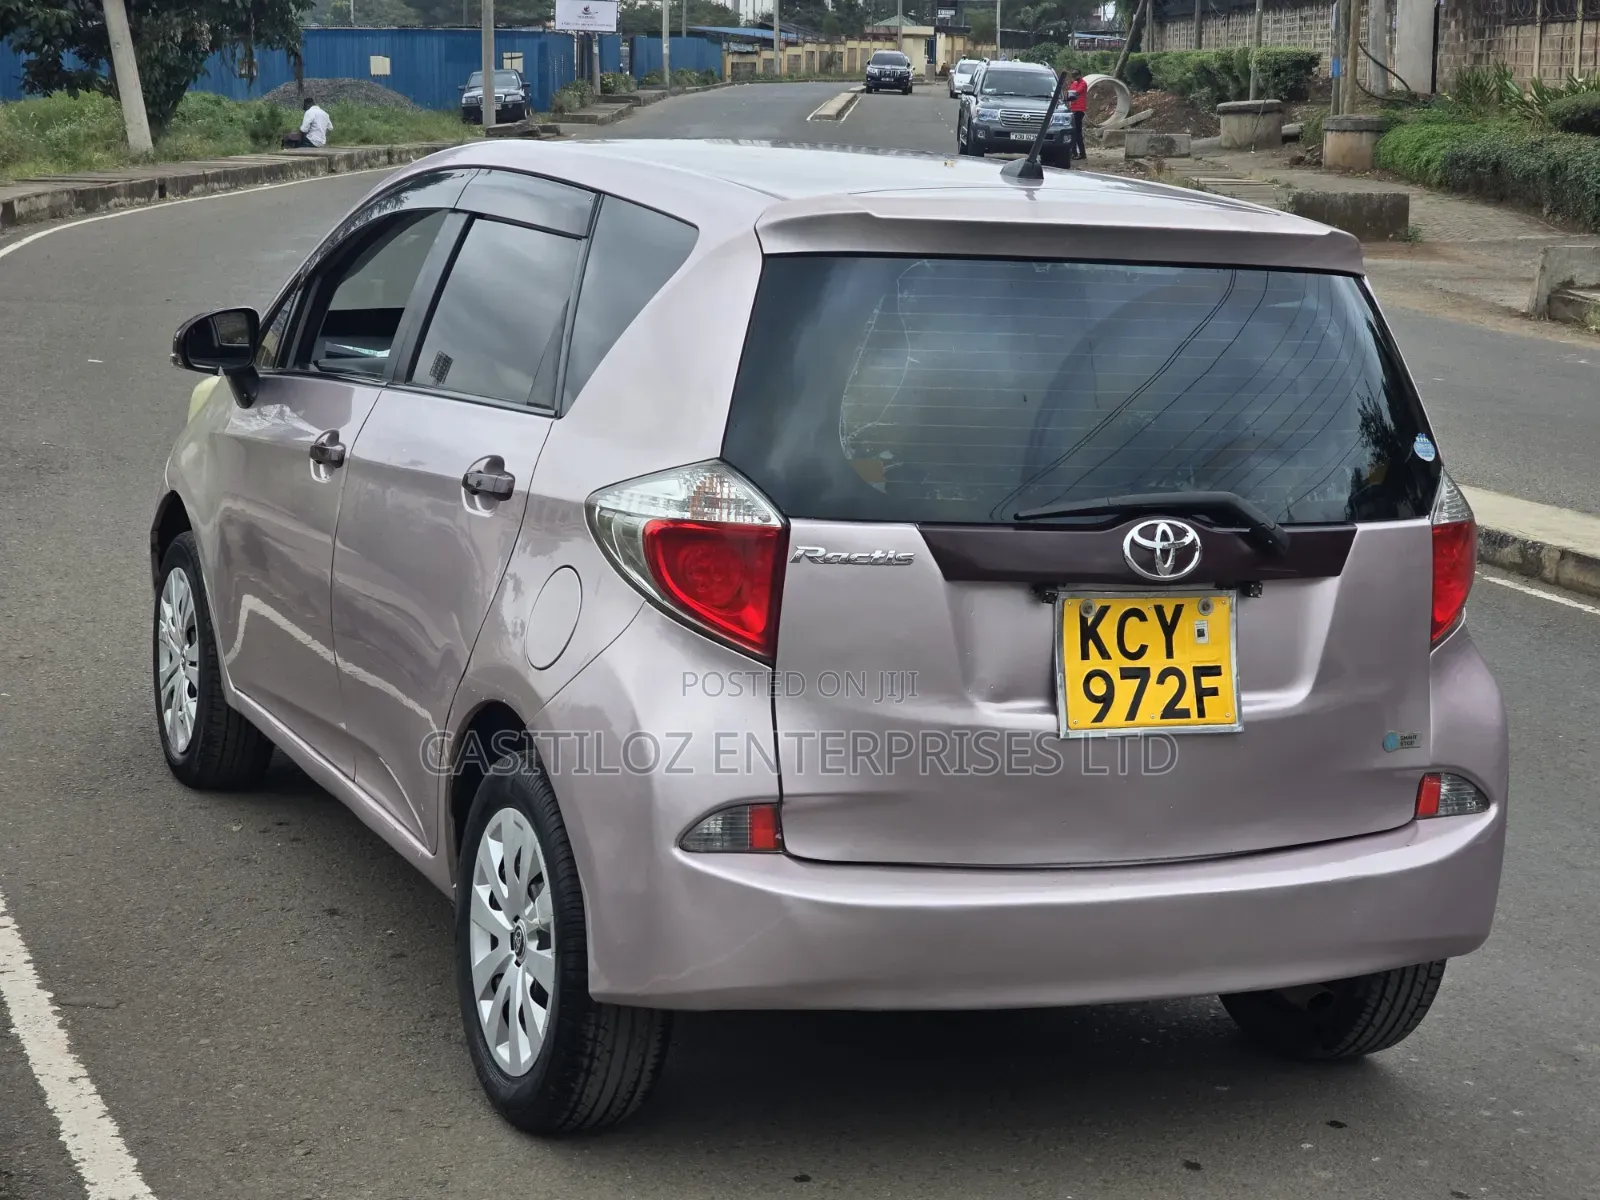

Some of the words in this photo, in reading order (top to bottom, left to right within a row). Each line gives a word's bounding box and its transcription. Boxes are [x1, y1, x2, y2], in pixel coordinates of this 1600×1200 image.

[789, 546, 915, 565] Ractis
[1079, 603, 1185, 661] KCY
[1082, 665, 1222, 723] 972F
